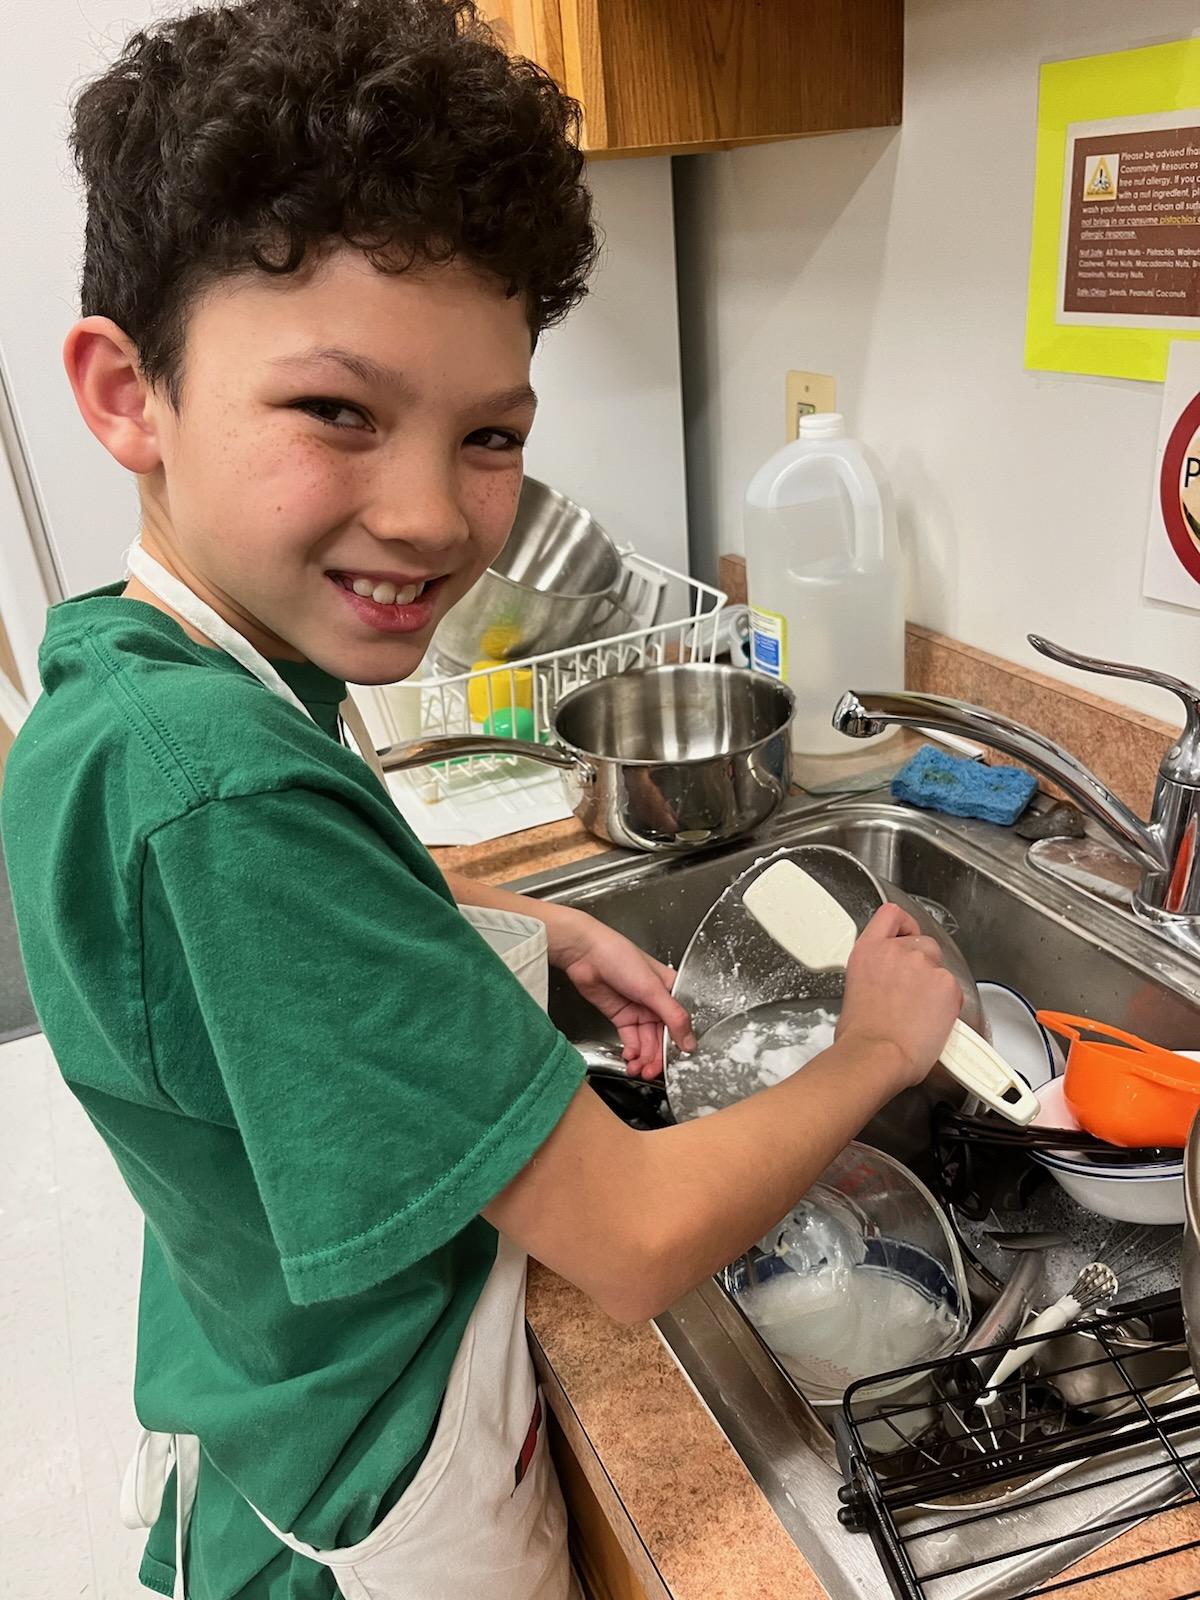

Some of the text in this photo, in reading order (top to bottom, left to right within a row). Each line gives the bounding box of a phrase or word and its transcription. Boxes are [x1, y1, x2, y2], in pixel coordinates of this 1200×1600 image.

[1121, 146, 1200, 160] Please be advised tha
[1120, 162, 1198, 174] Community Resources
[1146, 176, 1172, 186] allergy.
[1174, 174, 1180, 184] If
[1180, 176, 1195, 185] you
[1082, 200, 1200, 215] wash your hands and clean all surf
[1126, 217, 1159, 225] consume
